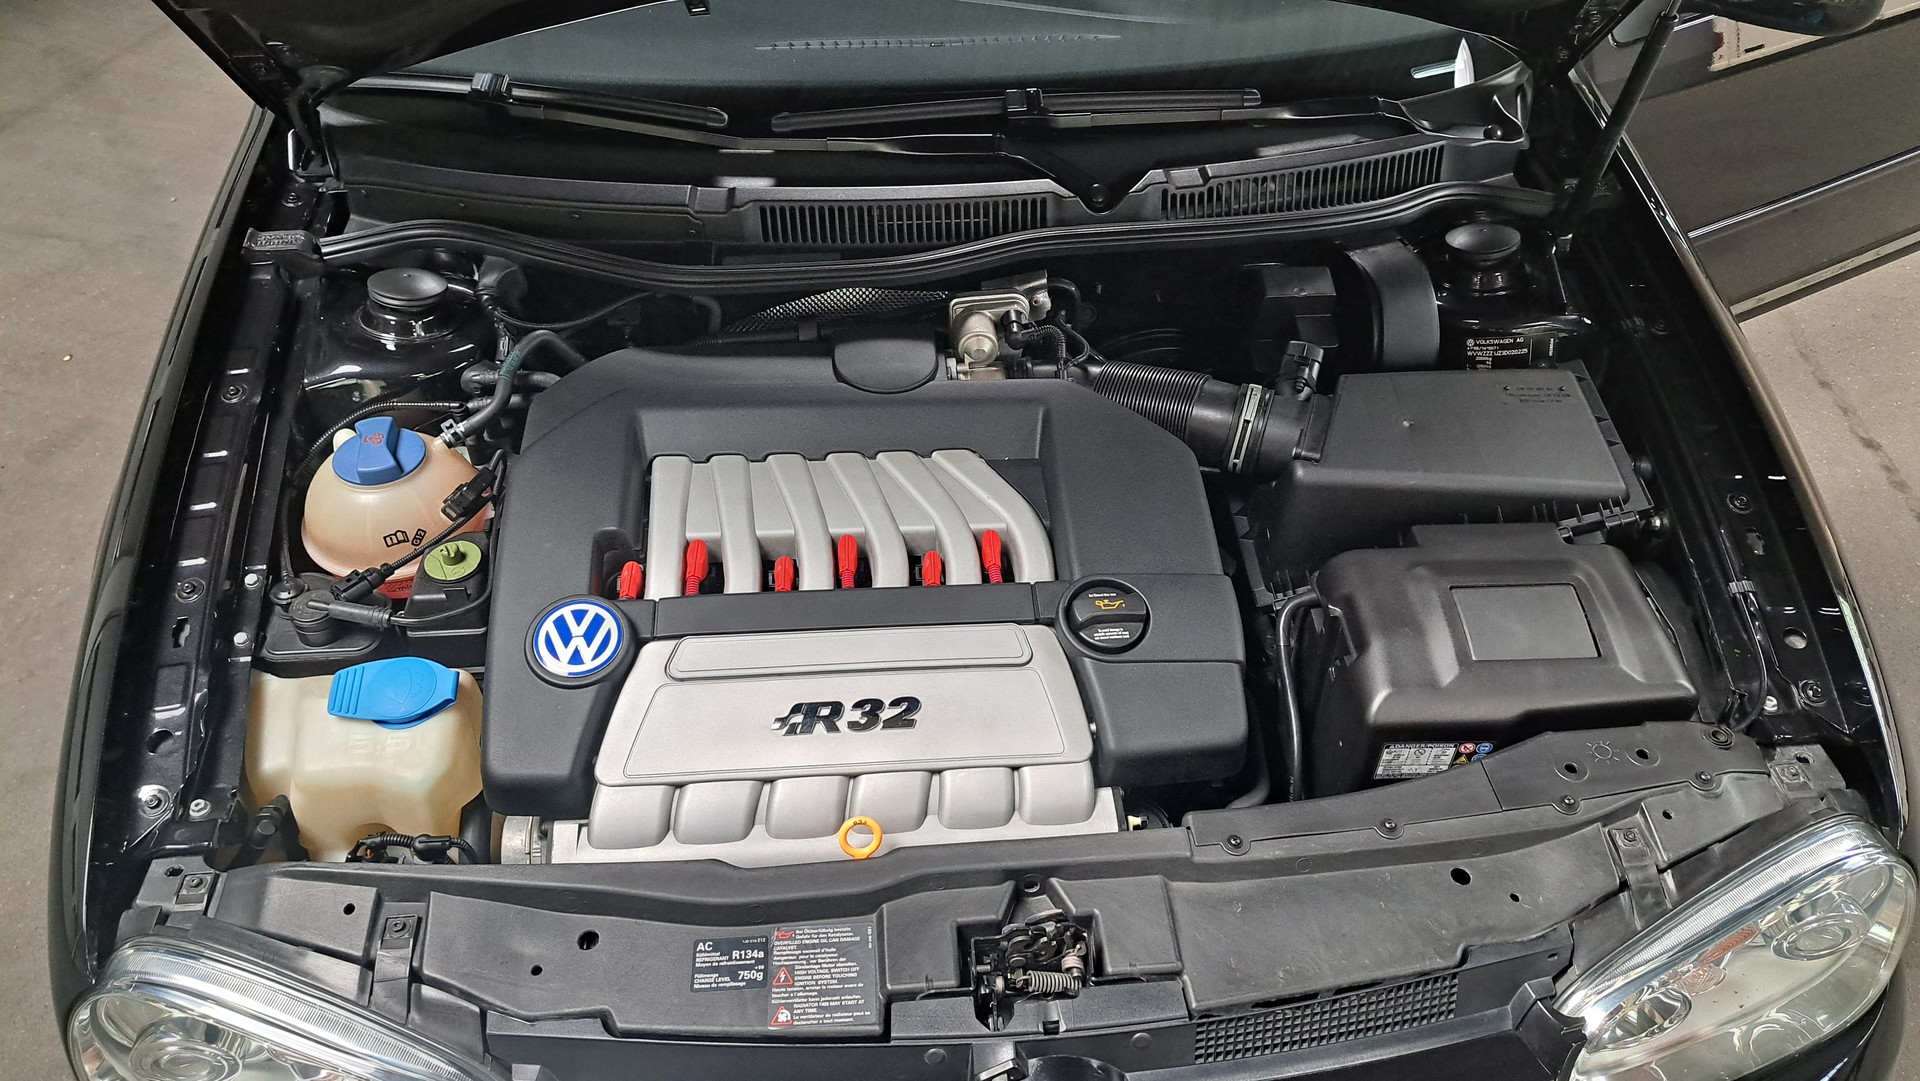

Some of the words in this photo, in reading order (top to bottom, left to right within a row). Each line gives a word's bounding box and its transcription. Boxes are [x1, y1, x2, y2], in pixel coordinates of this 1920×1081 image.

[412, 530, 425, 546] G12
[697, 942, 713, 951] AC
[732, 950, 764, 959] R134a
[738, 970, 763, 981] 750g
